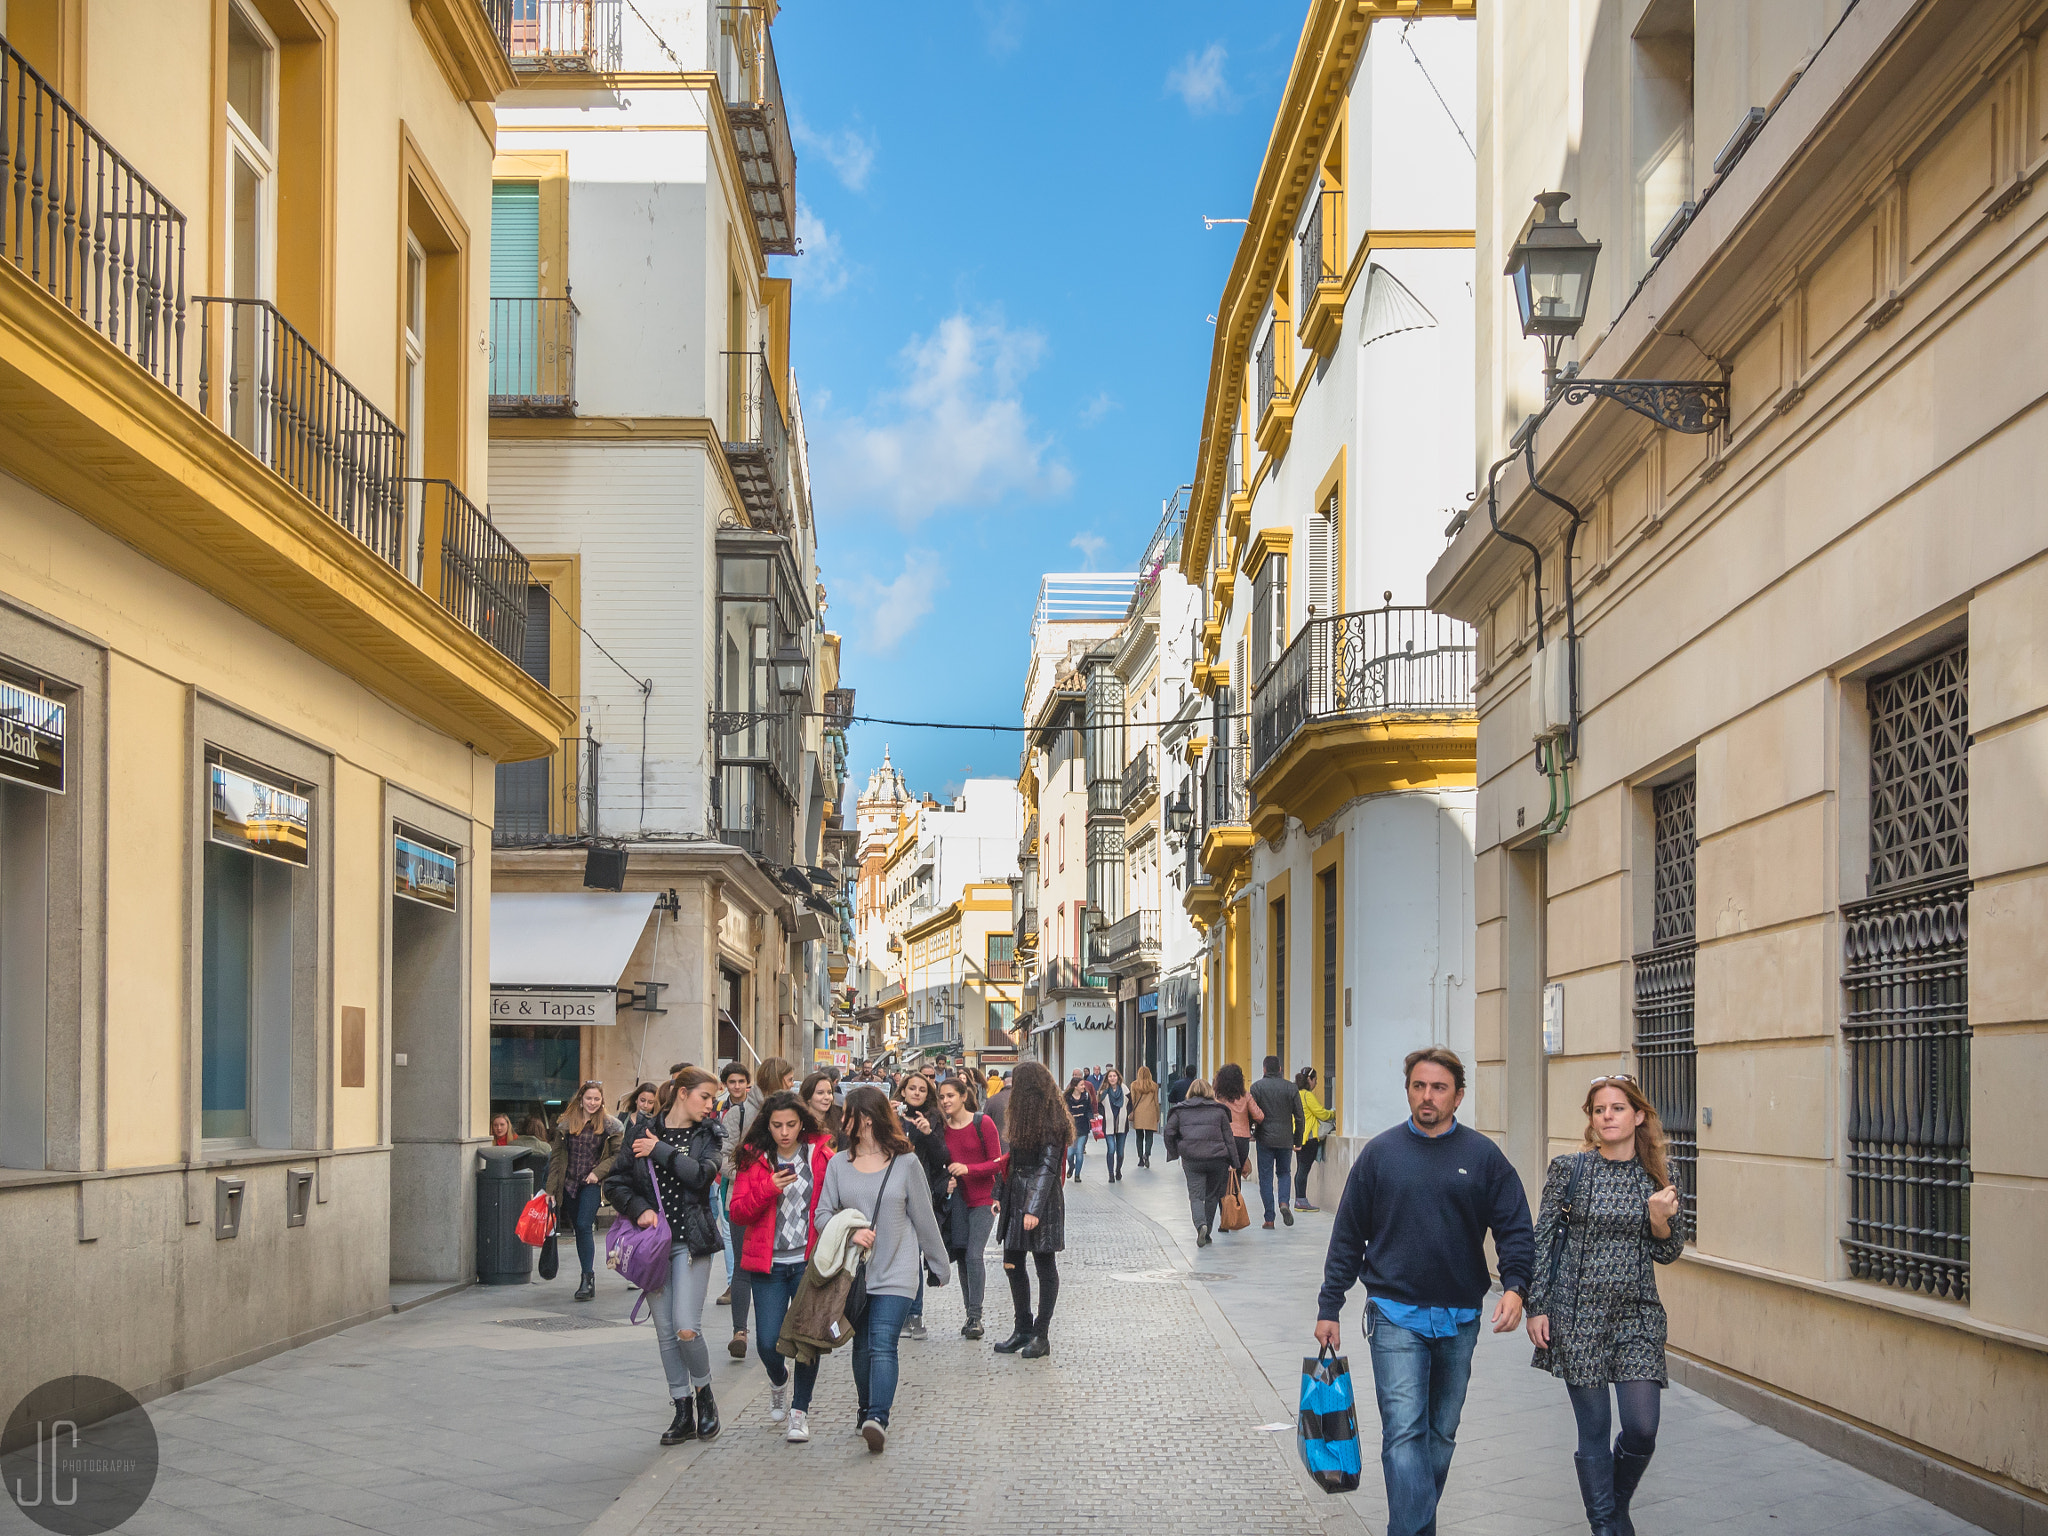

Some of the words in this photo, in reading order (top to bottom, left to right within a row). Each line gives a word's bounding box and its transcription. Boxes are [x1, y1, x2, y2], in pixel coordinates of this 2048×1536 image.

[490, 999, 510, 1015] fé
[518, 1001, 532, 1015] &
[539, 1001, 596, 1019] Tapas
[1072, 1014, 1117, 1031] ulank
[622, 1245, 634, 1273] adidas
